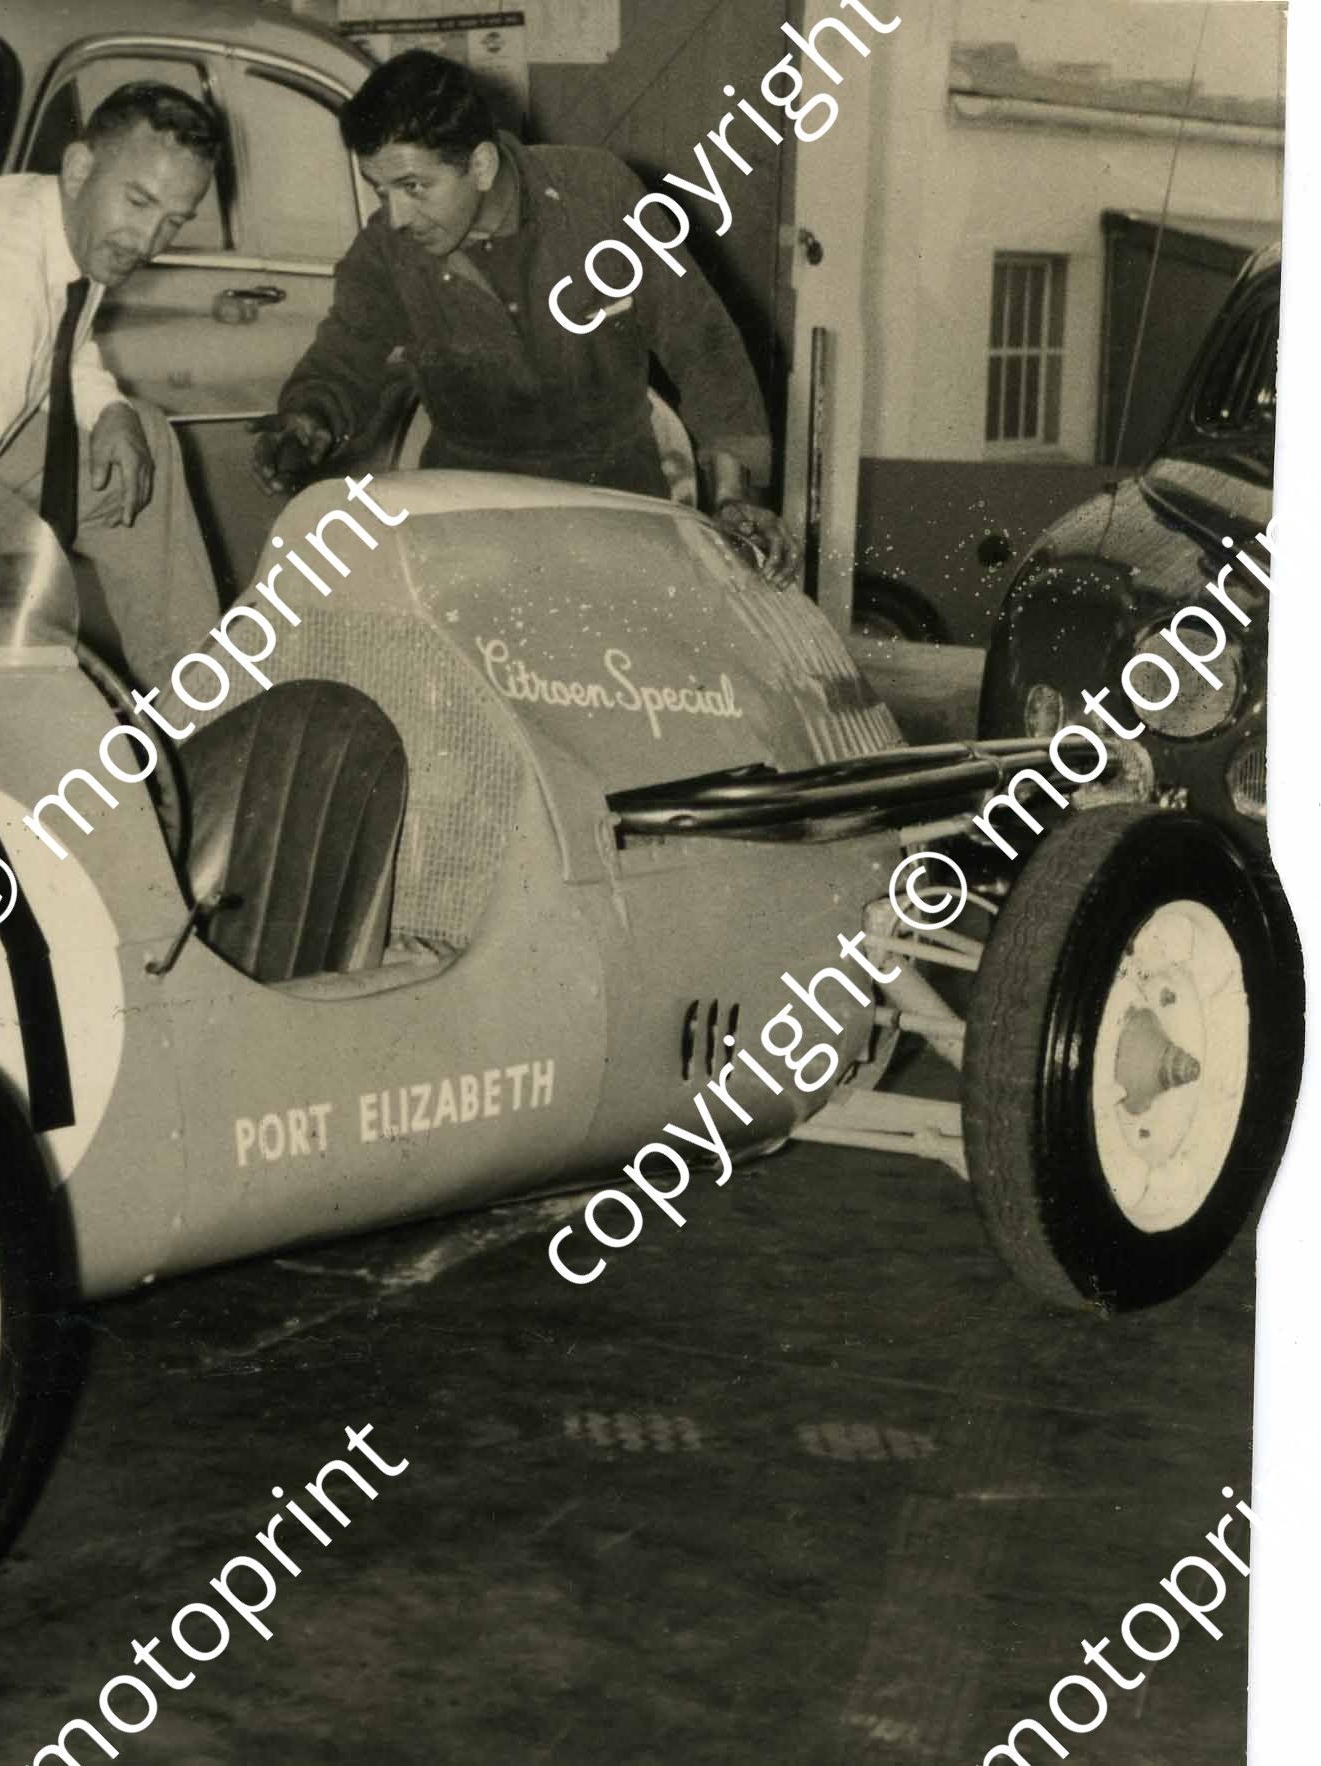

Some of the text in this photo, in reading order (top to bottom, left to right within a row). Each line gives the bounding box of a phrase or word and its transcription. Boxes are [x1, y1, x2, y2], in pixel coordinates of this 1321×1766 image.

[476, 635, 743, 739] Citroen Special
[235, 1059, 555, 1167] PORT ELIZABETH
